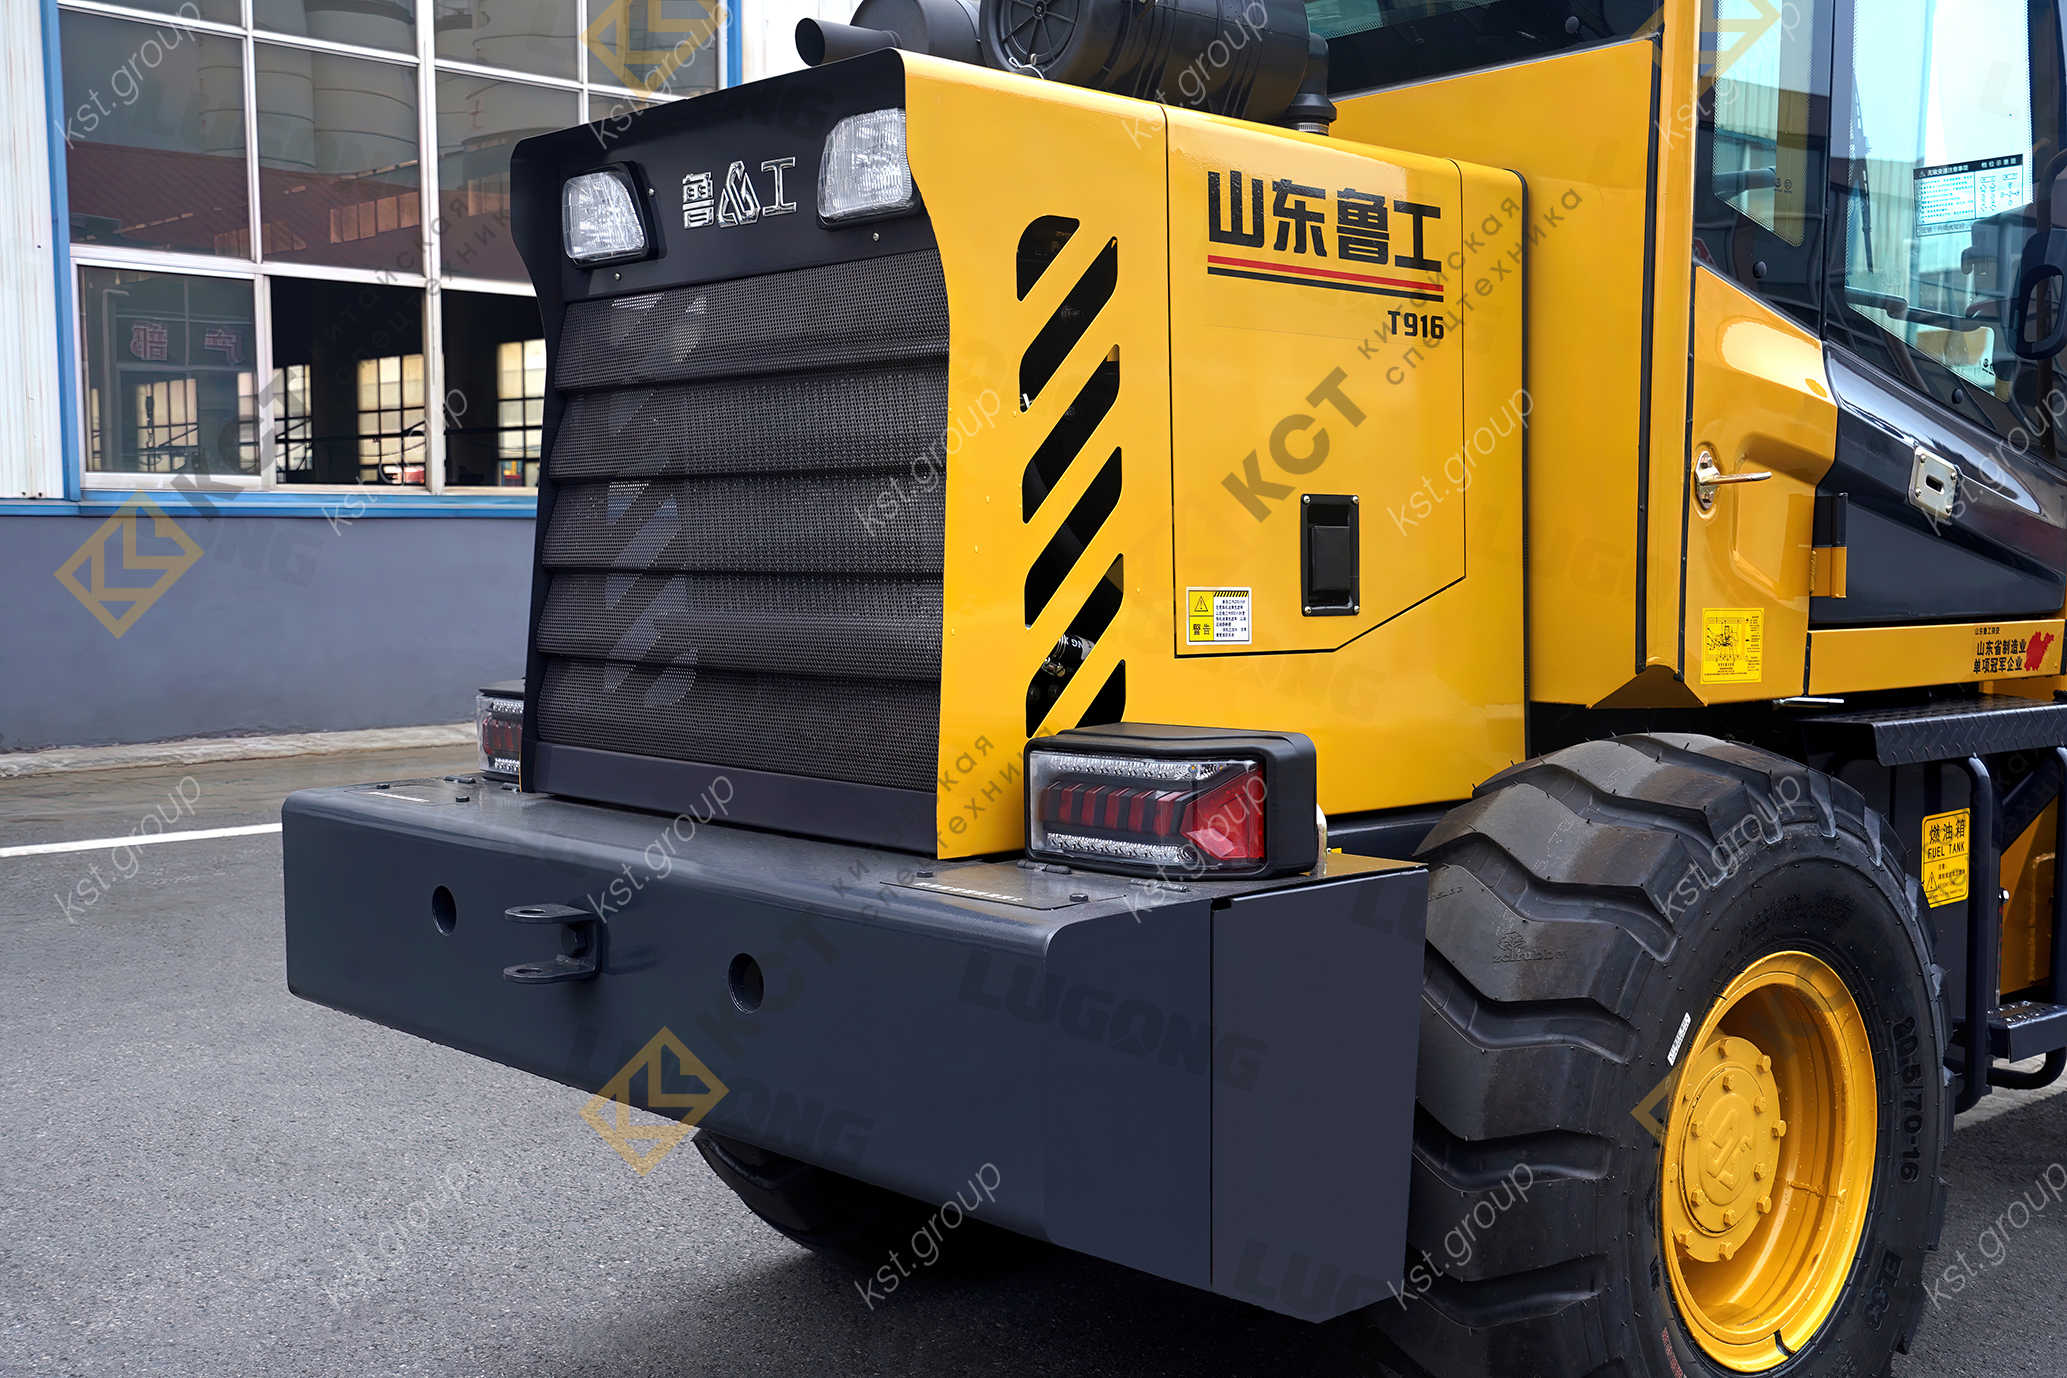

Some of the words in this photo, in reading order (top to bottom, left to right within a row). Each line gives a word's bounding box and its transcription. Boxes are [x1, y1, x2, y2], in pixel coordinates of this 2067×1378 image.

[1208, 170, 1442, 272] 山东鲁工
[1387, 311, 1445, 339] T916
[1977, 639, 2027, 656] 山东省制造业
[1973, 656, 2023, 675] 单项冠军企业
[1928, 818, 1967, 845] 燃油箱
[1927, 846, 1946, 859] FUEL
[1949, 841, 1966, 855] TANK
